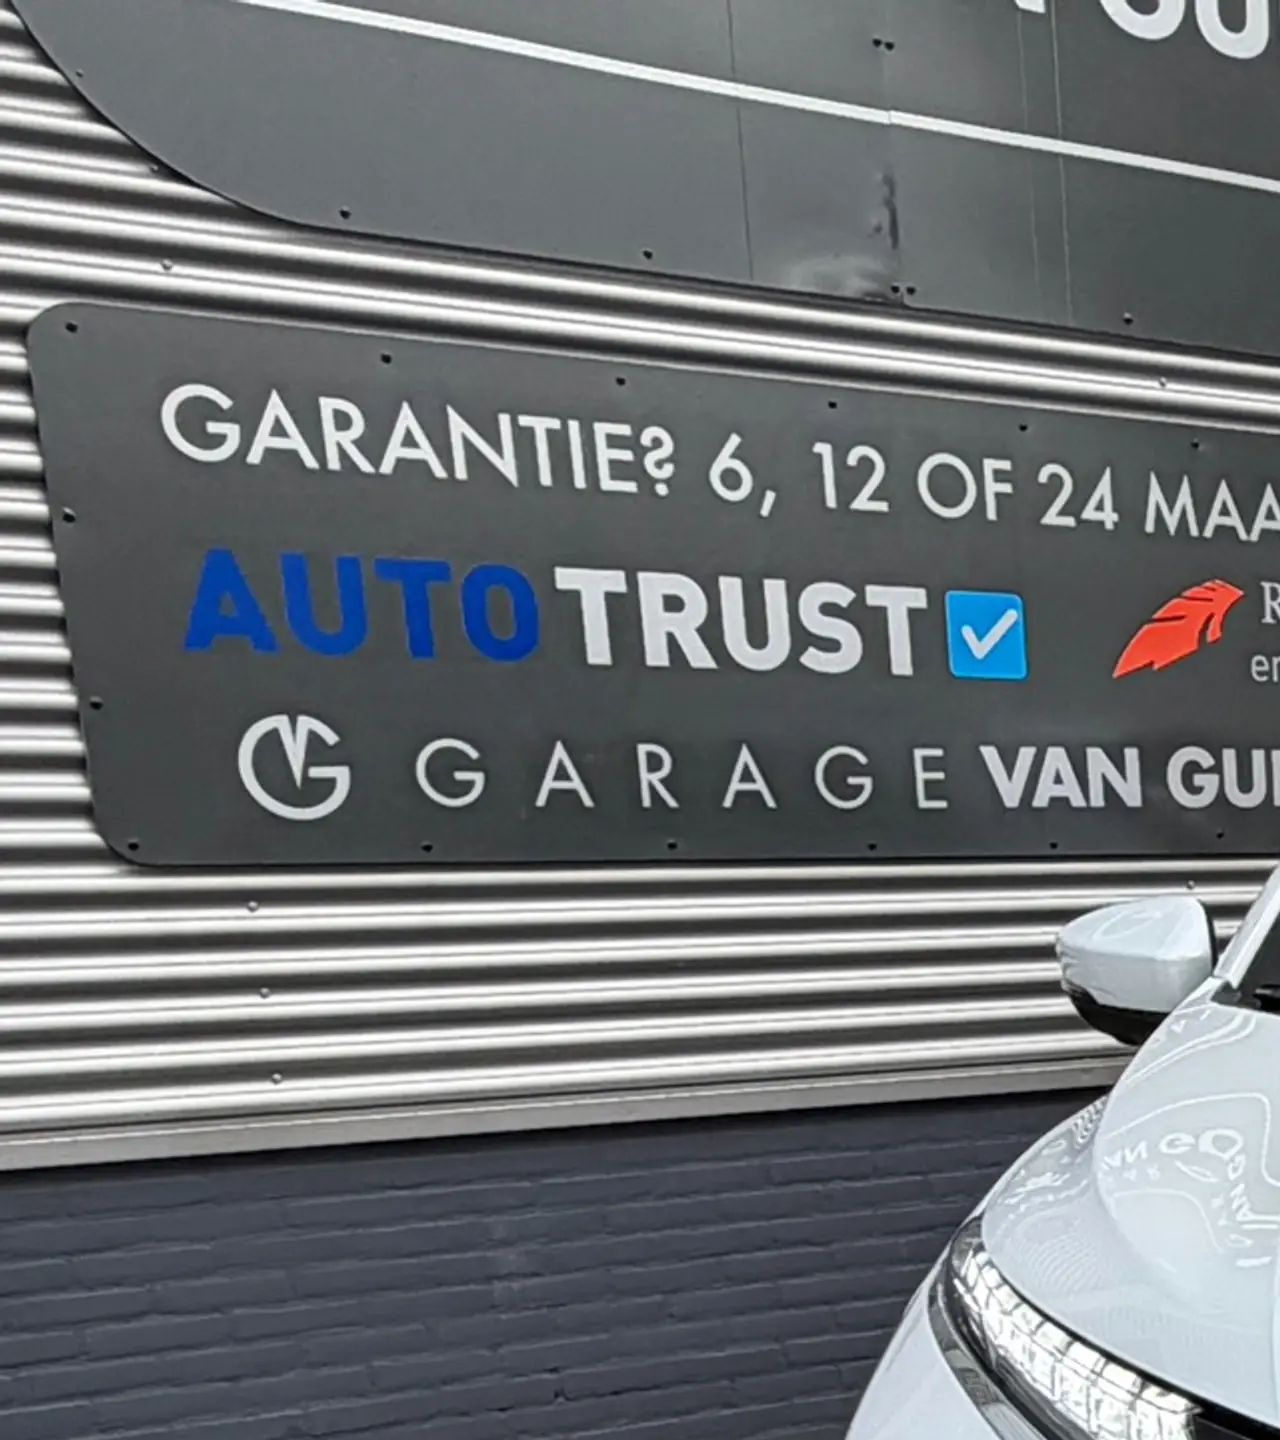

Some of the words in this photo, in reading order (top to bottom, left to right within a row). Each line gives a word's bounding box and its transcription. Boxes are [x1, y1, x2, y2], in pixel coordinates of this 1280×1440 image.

[160, 383, 677, 499] GARANTIE?
[708, 431, 778, 519] 6,
[811, 441, 890, 513] 12
[916, 451, 1014, 521] OF
[1036, 462, 1121, 532] 24
[414, 737, 949, 808] GARAGE
[980, 746, 1141, 808] VAN
